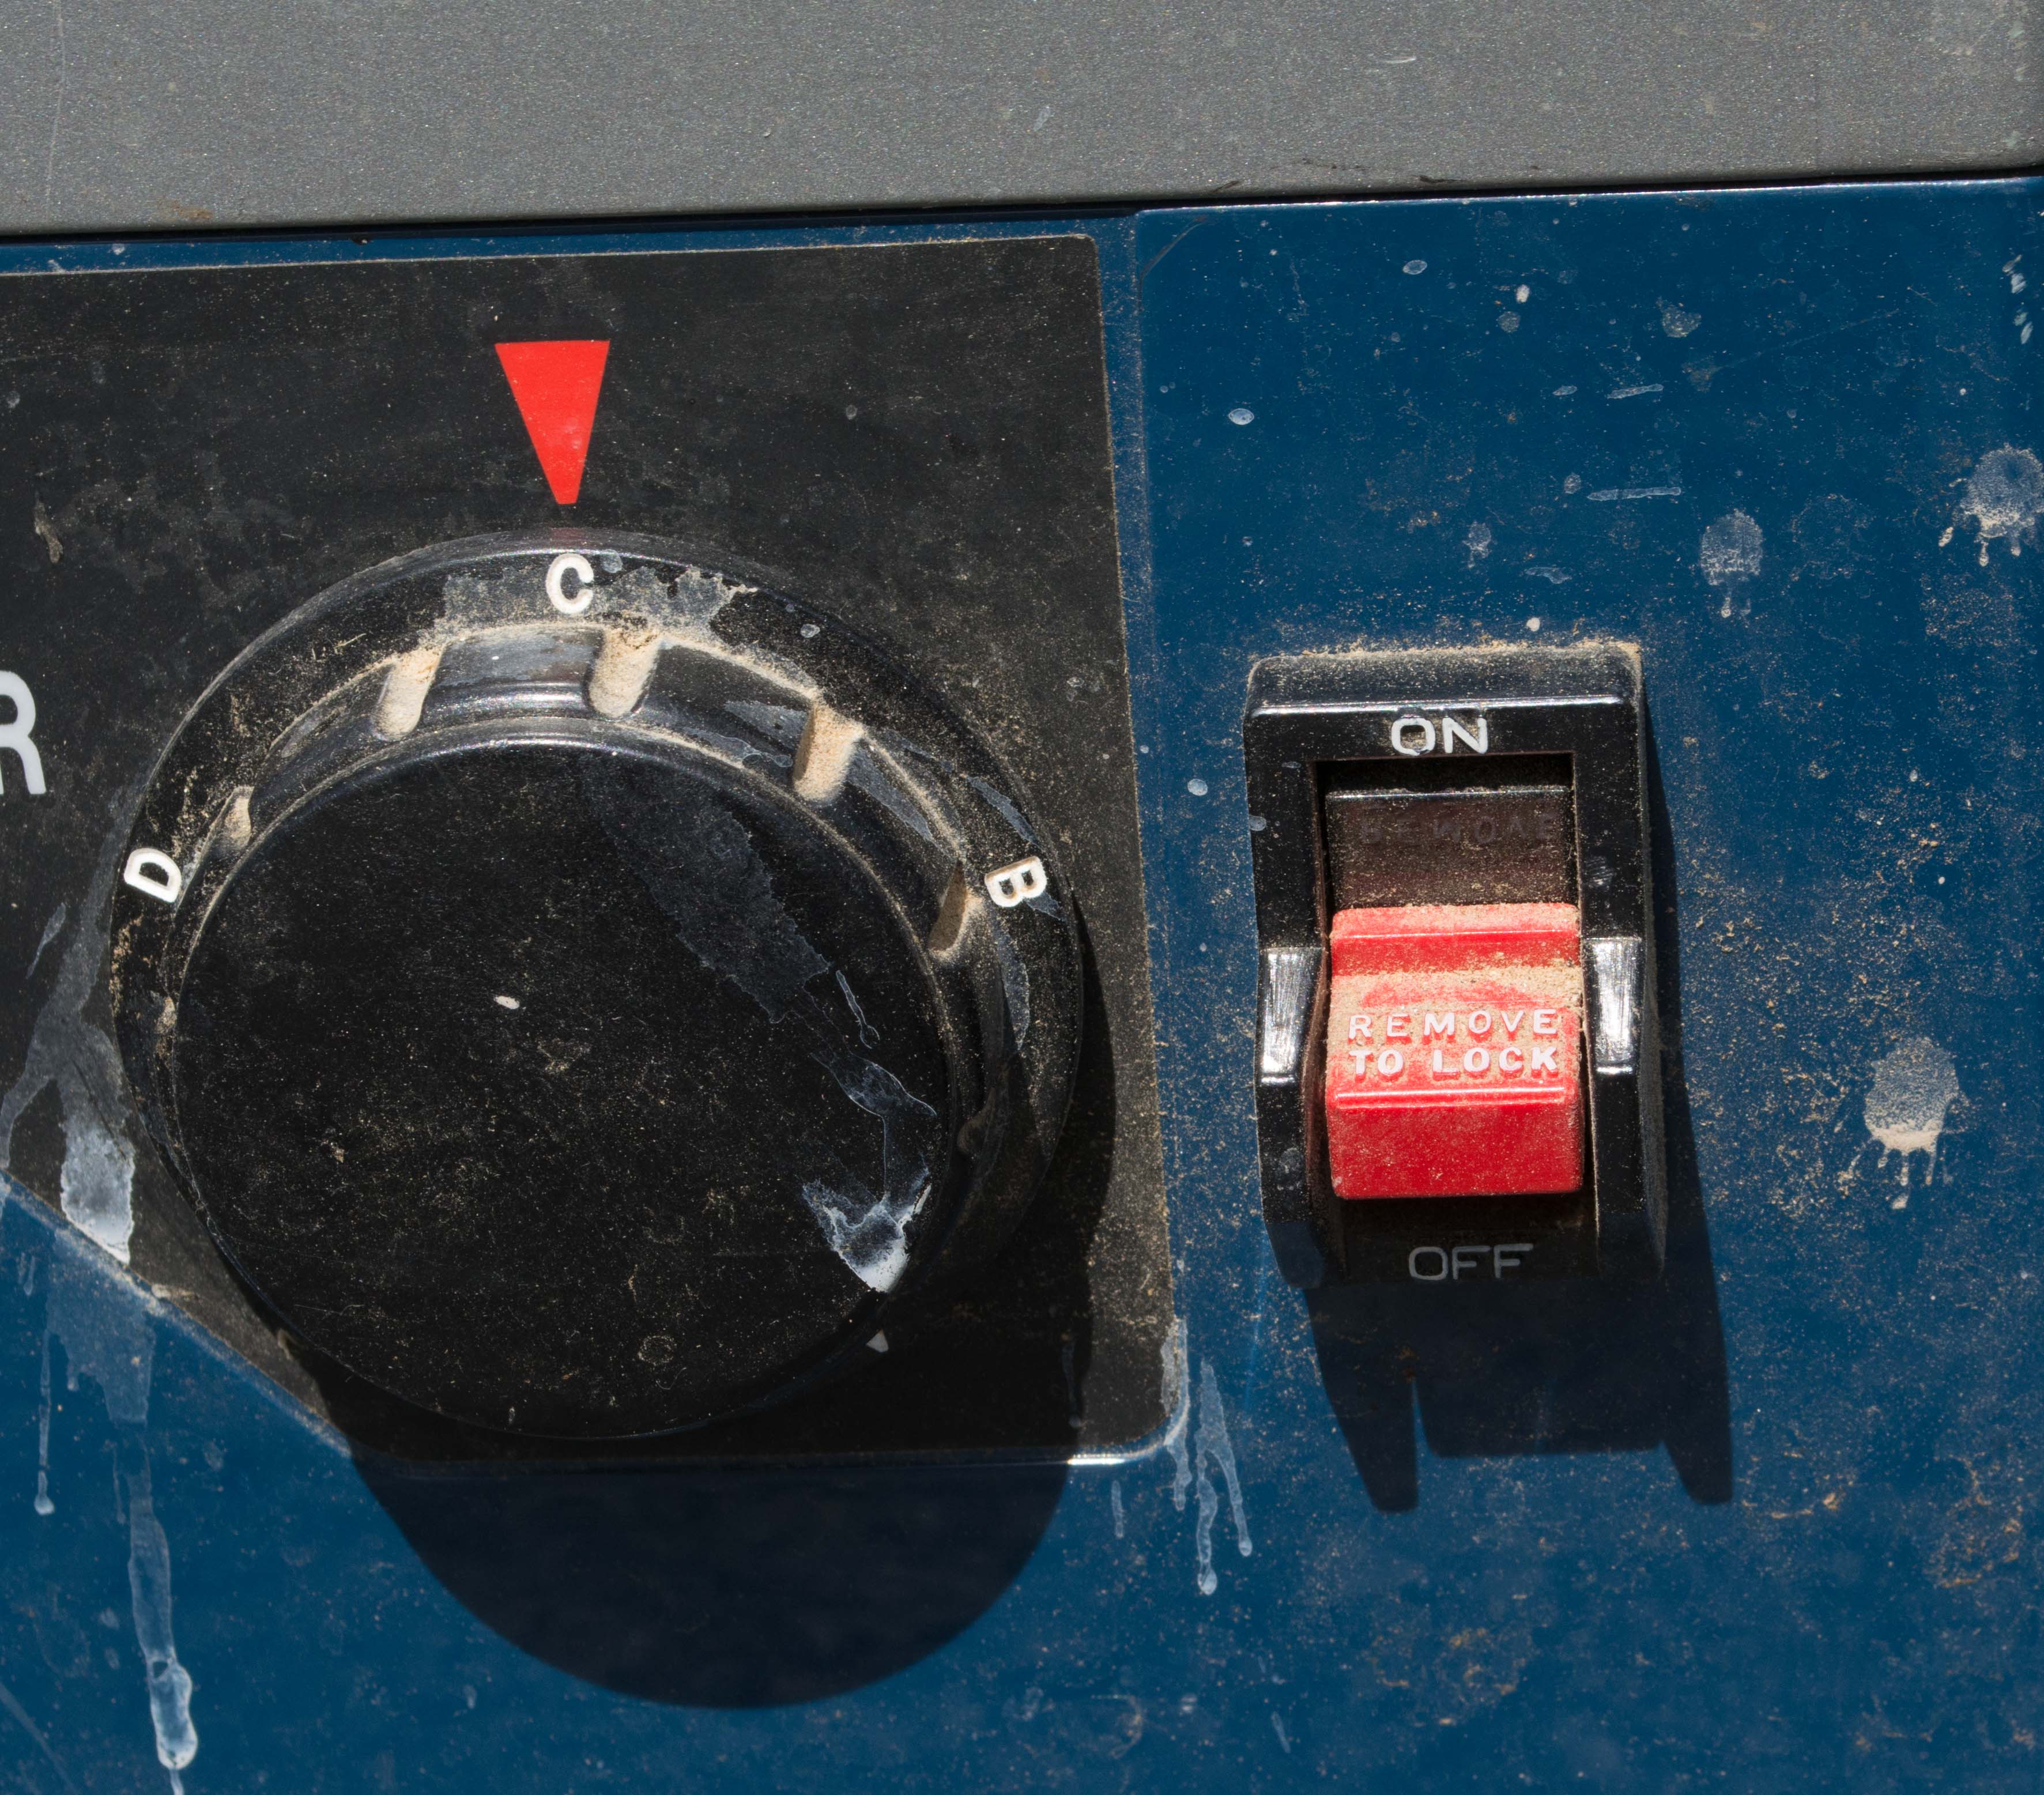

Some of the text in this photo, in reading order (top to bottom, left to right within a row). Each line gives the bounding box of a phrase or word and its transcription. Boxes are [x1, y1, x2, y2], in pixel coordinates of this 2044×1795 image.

[546, 552, 594, 614] C
[1390, 715, 1488, 756] ON
[123, 847, 182, 903] D
[984, 855, 1048, 907] B
[1347, 1009, 1558, 1040] REMOVE
[1348, 1046, 1559, 1077] TO LOCK
[1407, 1242, 1535, 1281] OFF
